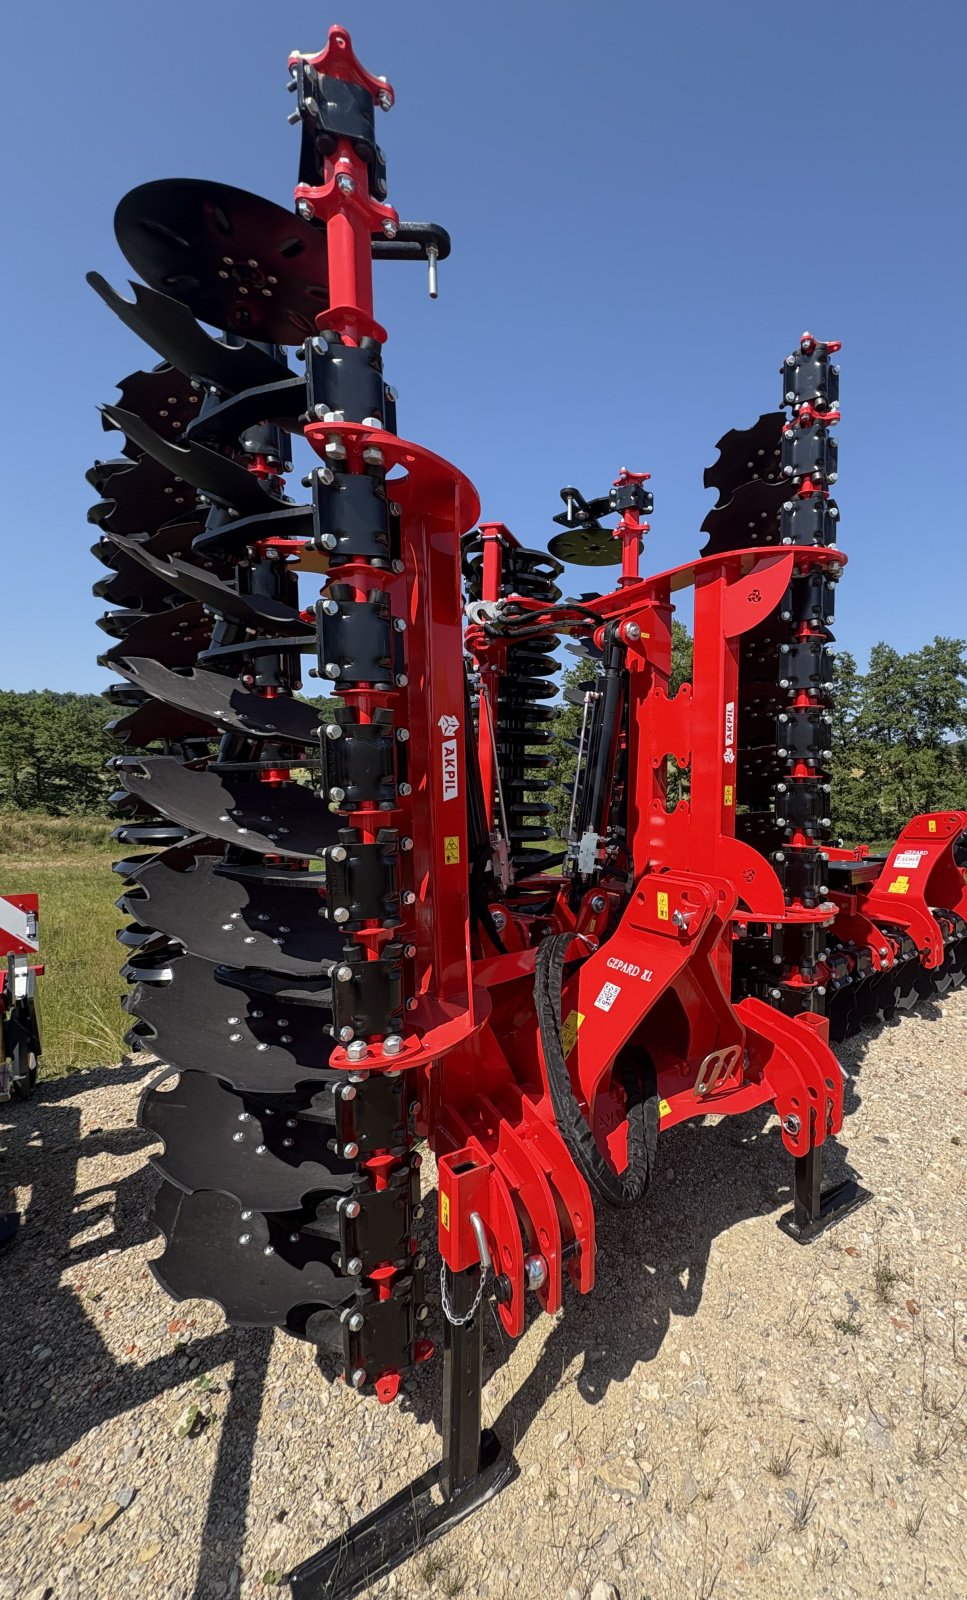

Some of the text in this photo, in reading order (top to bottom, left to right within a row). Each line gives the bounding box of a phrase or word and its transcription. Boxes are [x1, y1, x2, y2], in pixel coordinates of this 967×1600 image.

[726, 707, 734, 741] AKPIL
[444, 746, 455, 793] AKPIL
[606, 957, 654, 982] GEPARD XL
